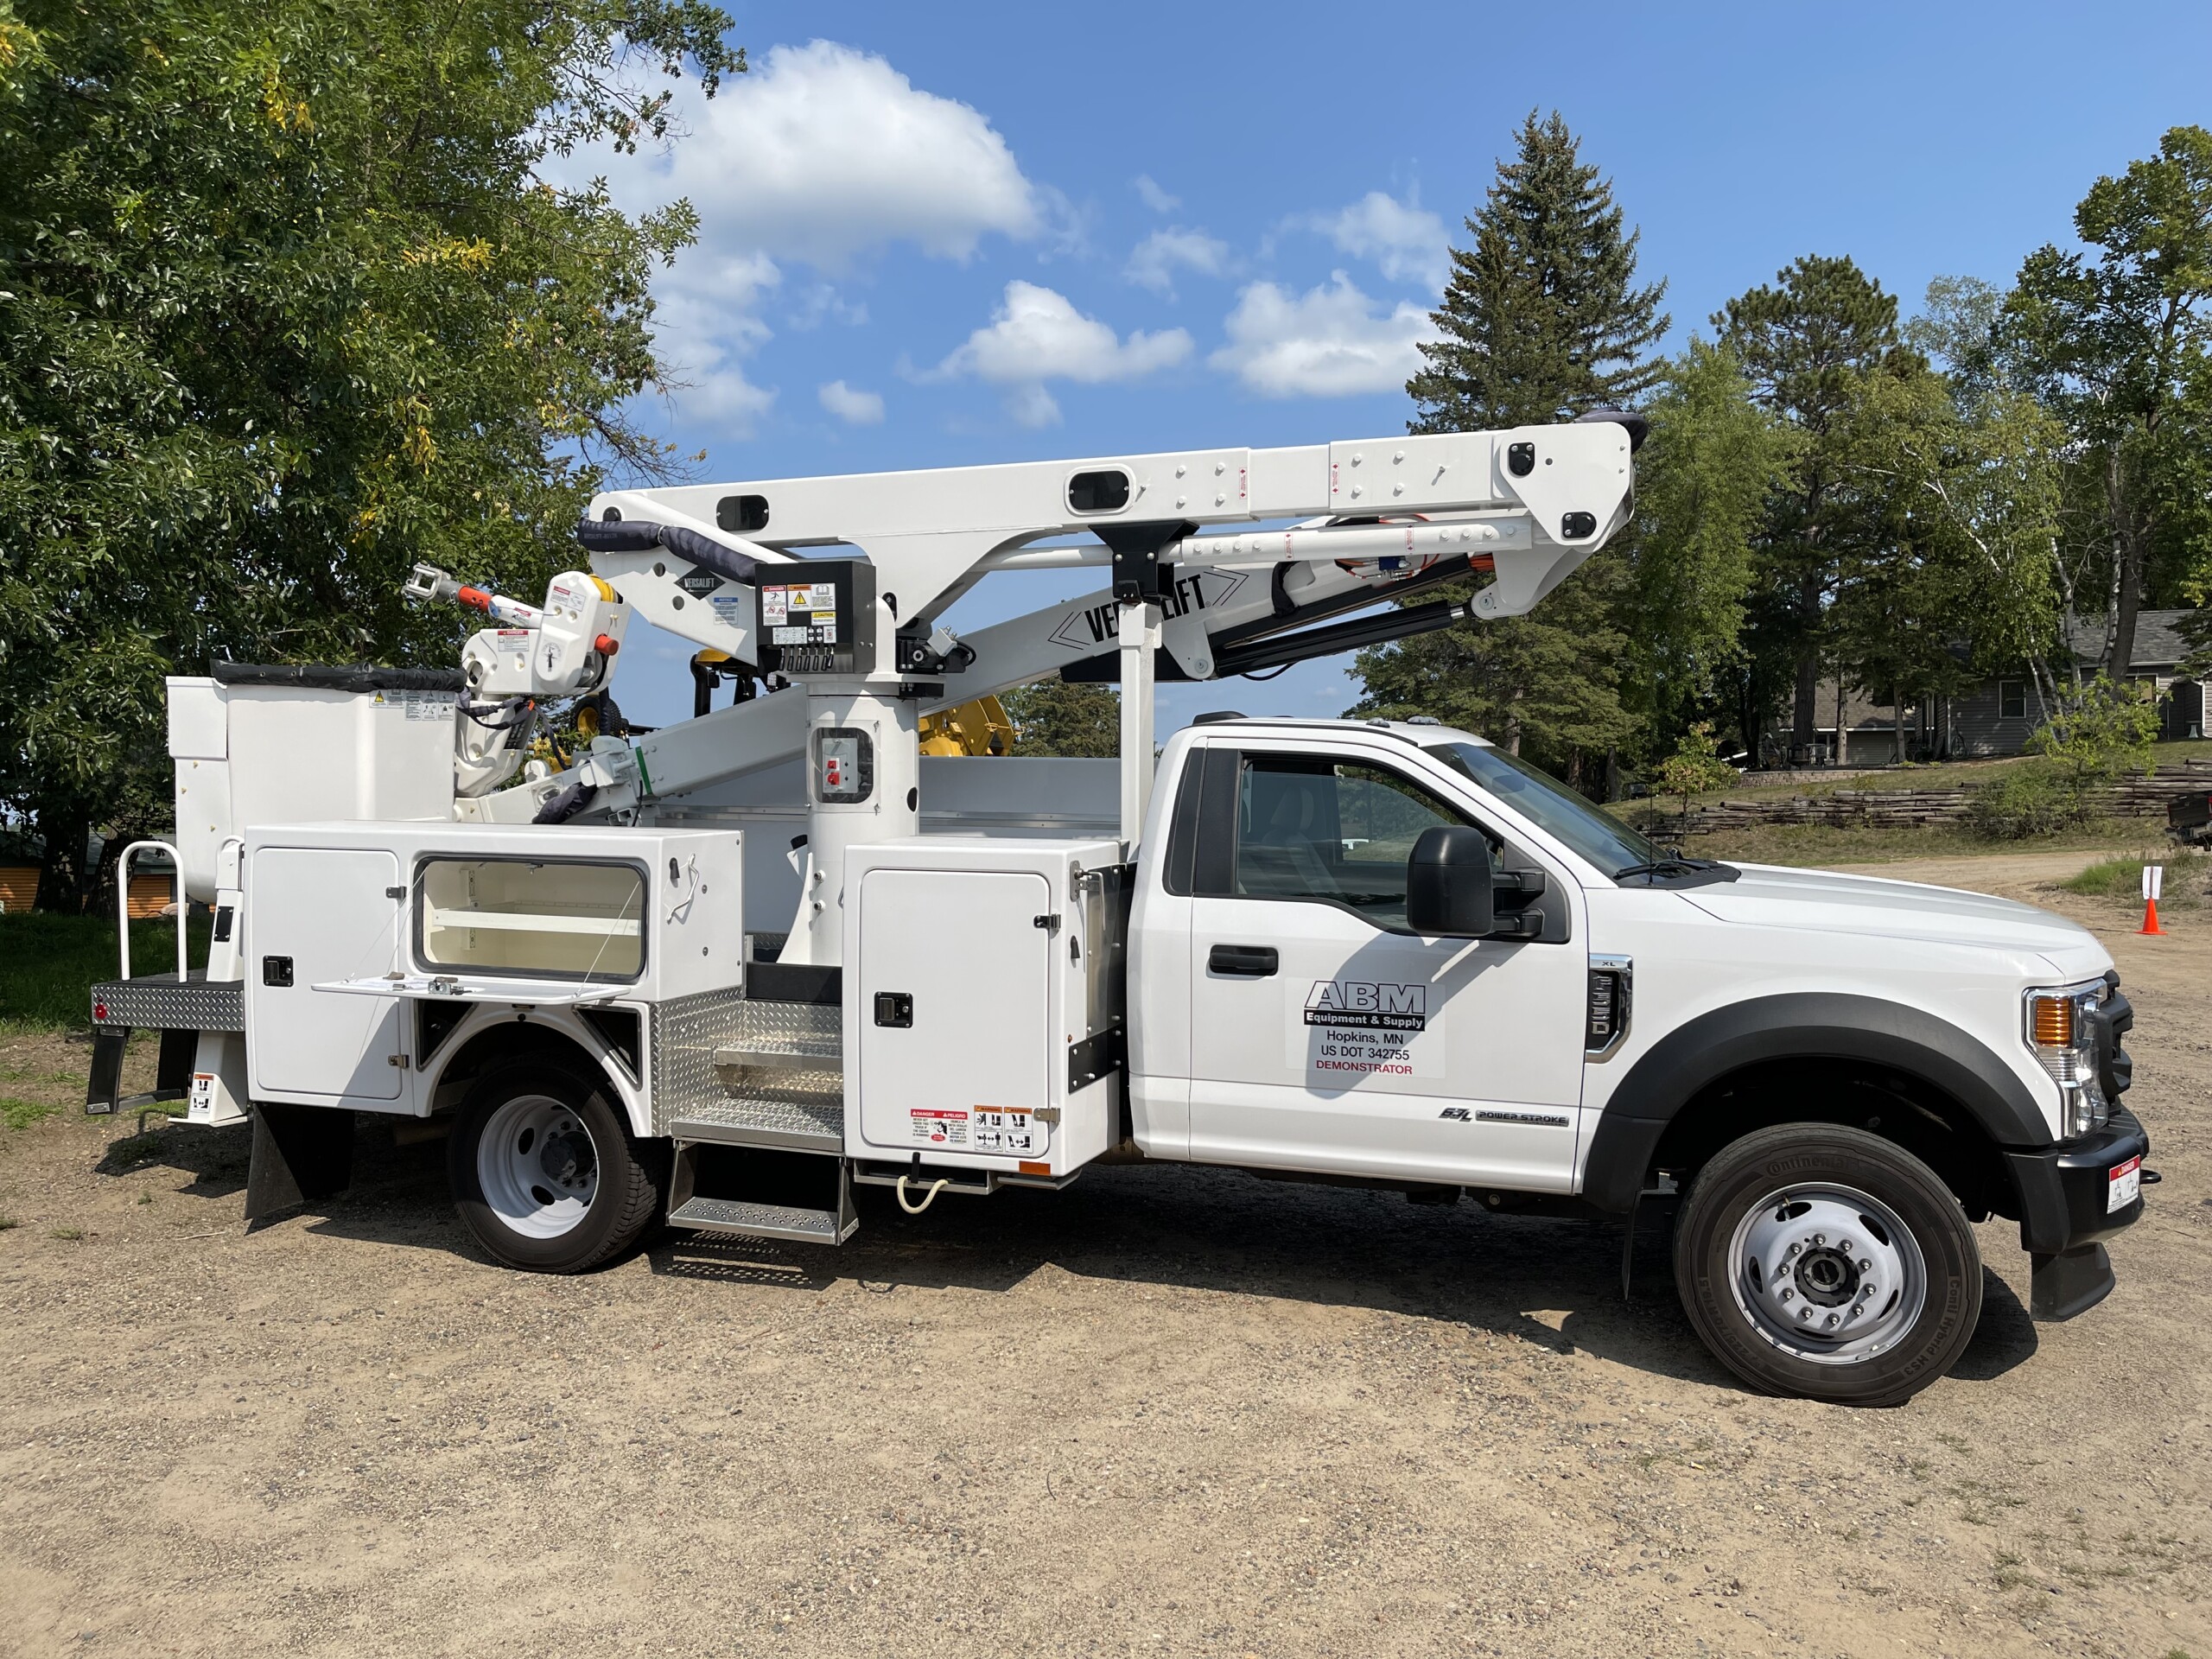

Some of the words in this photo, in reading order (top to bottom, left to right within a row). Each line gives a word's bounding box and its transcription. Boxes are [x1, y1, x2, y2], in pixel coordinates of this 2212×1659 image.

[683, 577, 715, 588] VERSALIFT
[1084, 574, 1205, 643] VELIFT
[1304, 980, 1426, 1014] ABM
[1306, 1012, 1368, 1025] Equipment
[1370, 1015, 1380, 1025] &
[1382, 1015, 1423, 1029] Supply
[1326, 1029, 1379, 1045] Hopkins,
[1383, 1033, 1404, 1045] MN
[1320, 1045, 1337, 1057] US
[1340, 1046, 1364, 1058] DOT
[1368, 1047, 1410, 1061] 342755
[1316, 1059, 1413, 1075] DEMONSTRATOR
[1478, 1111, 1518, 1121] POWER
[1521, 1114, 1567, 1123] STROKE
[1765, 1154, 1848, 1177] Continental
[1926, 1317, 1955, 1356] Hybrid
[1904, 1354, 1929, 1376] HS3
